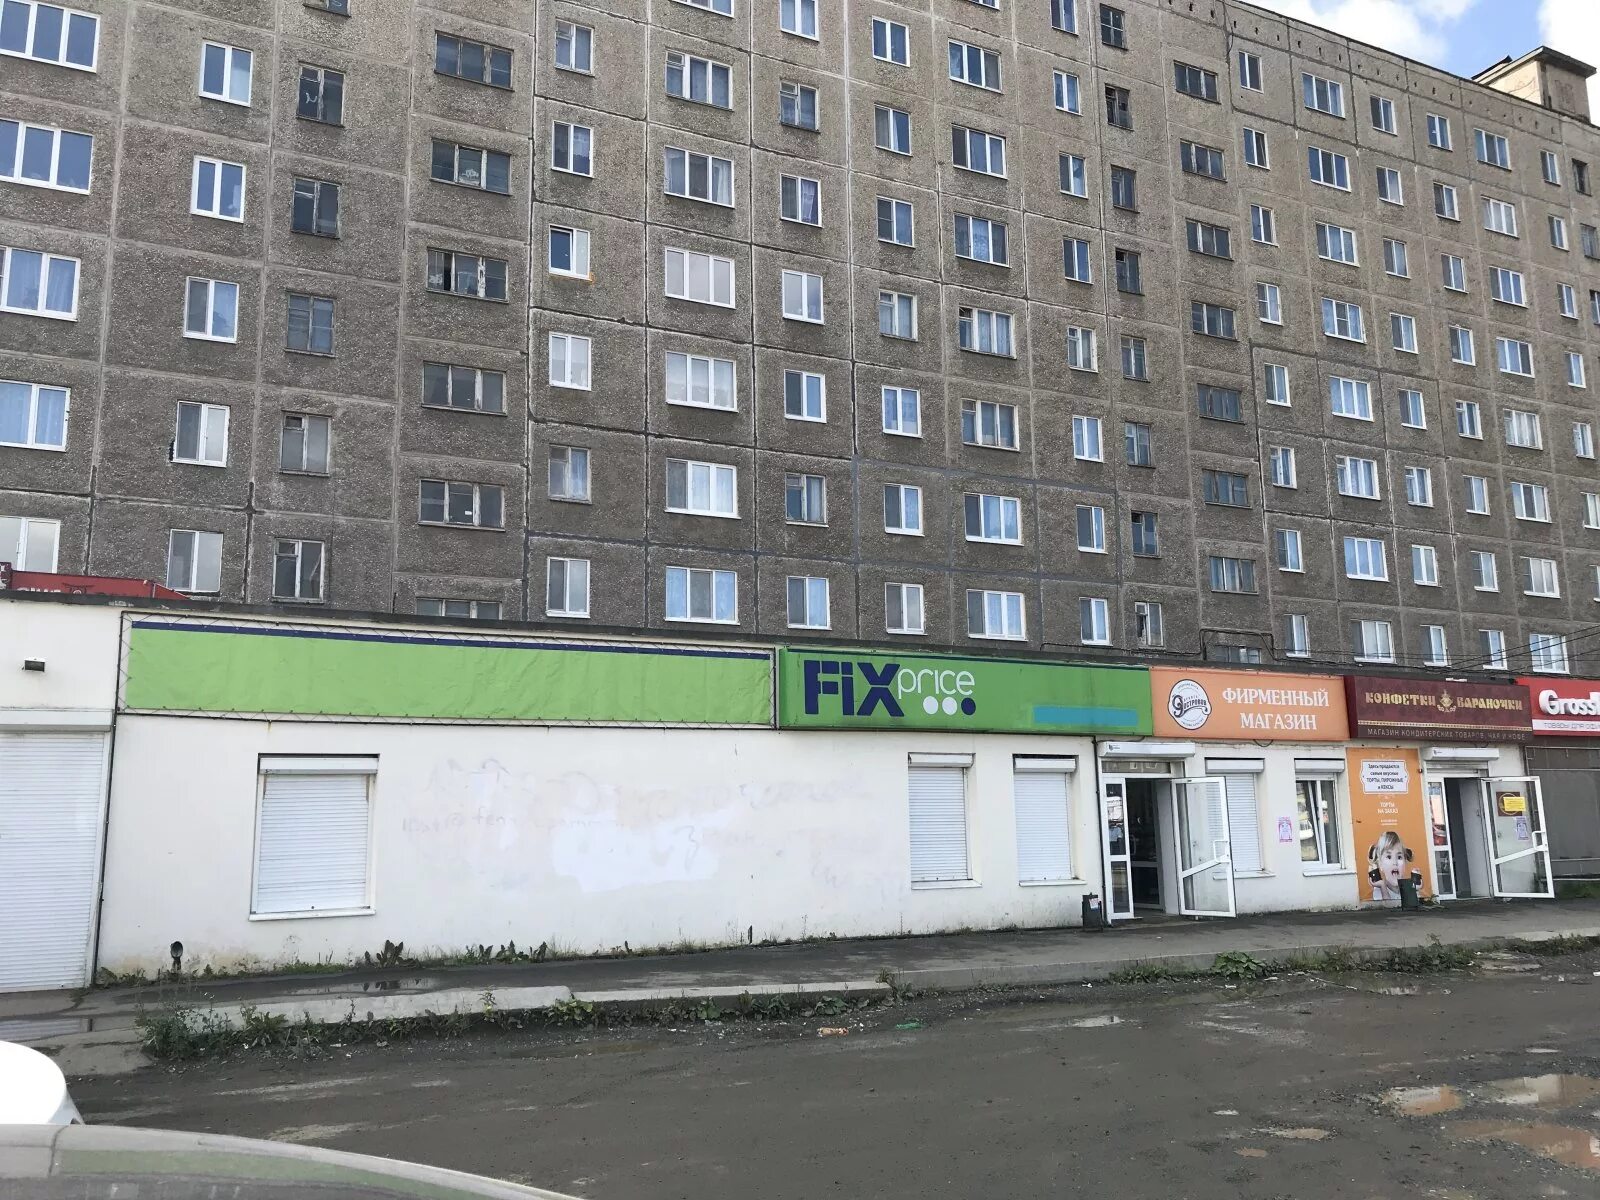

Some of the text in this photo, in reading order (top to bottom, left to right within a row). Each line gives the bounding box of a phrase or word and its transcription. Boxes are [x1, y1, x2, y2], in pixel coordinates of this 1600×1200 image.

[898, 668, 975, 699] price
[1222, 688, 1330, 707] ФИРМЕННЫЙ
[1365, 692, 1523, 710] КОНФЕТКИ БАРАНОЧКИ
[1240, 712, 1317, 730] МАГАЗИН
[1367, 728, 1399, 736] МАГАЗИН
[1401, 729, 1453, 738] КОНДИТЕРСКИХ
